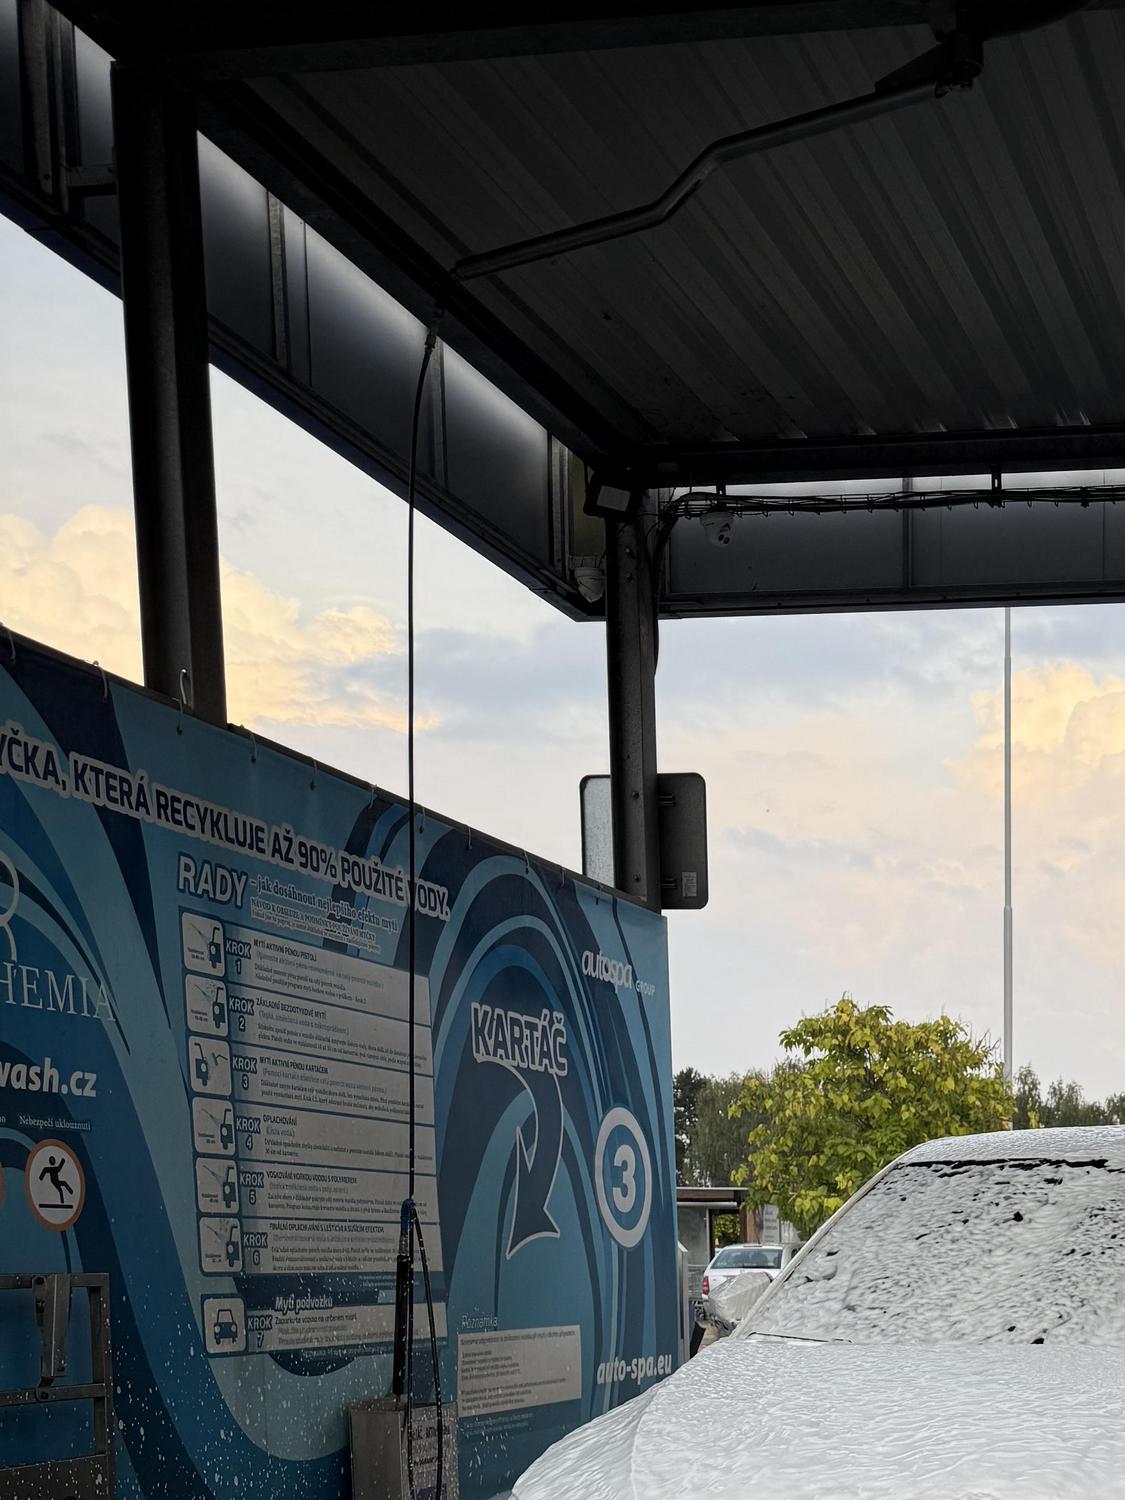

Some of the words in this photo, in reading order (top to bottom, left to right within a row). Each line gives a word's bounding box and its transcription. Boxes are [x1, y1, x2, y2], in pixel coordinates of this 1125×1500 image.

[74, 760, 151, 816] KTERÁ
[156, 789, 265, 854] RECYKLUJE
[271, 829, 294, 864] AŽ
[298, 841, 337, 879] 90%
[341, 855, 404, 901] POUŽITÉ
[179, 853, 247, 907] RADY
[257, 875, 272, 896] jak
[273, 881, 317, 908] dosáhnout
[226, 939, 251, 959] KROK
[235, 959, 241, 975] 1
[582, 950, 632, 992] autospa
[637, 980, 655, 996] GROUP
[229, 997, 254, 1017] KROK
[239, 1016, 245, 1031] 2
[472, 1003, 567, 1075] KARTÁČ
[232, 1056, 257, 1074] KROK
[242, 1074, 249, 1090] 3
[236, 1115, 261, 1133] KROK
[245, 1135, 253, 1151] 4
[239, 1171, 264, 1189] KROK
[612, 1144, 636, 1213] 3
[249, 1189, 256, 1205] 5
[243, 1232, 268, 1248] KROK
[253, 1250, 260, 1265] 6
[248, 1315, 272, 1330] KROK
[257, 1333, 264, 1347] 7
[596, 1354, 672, 1386] auto-spa.eu
